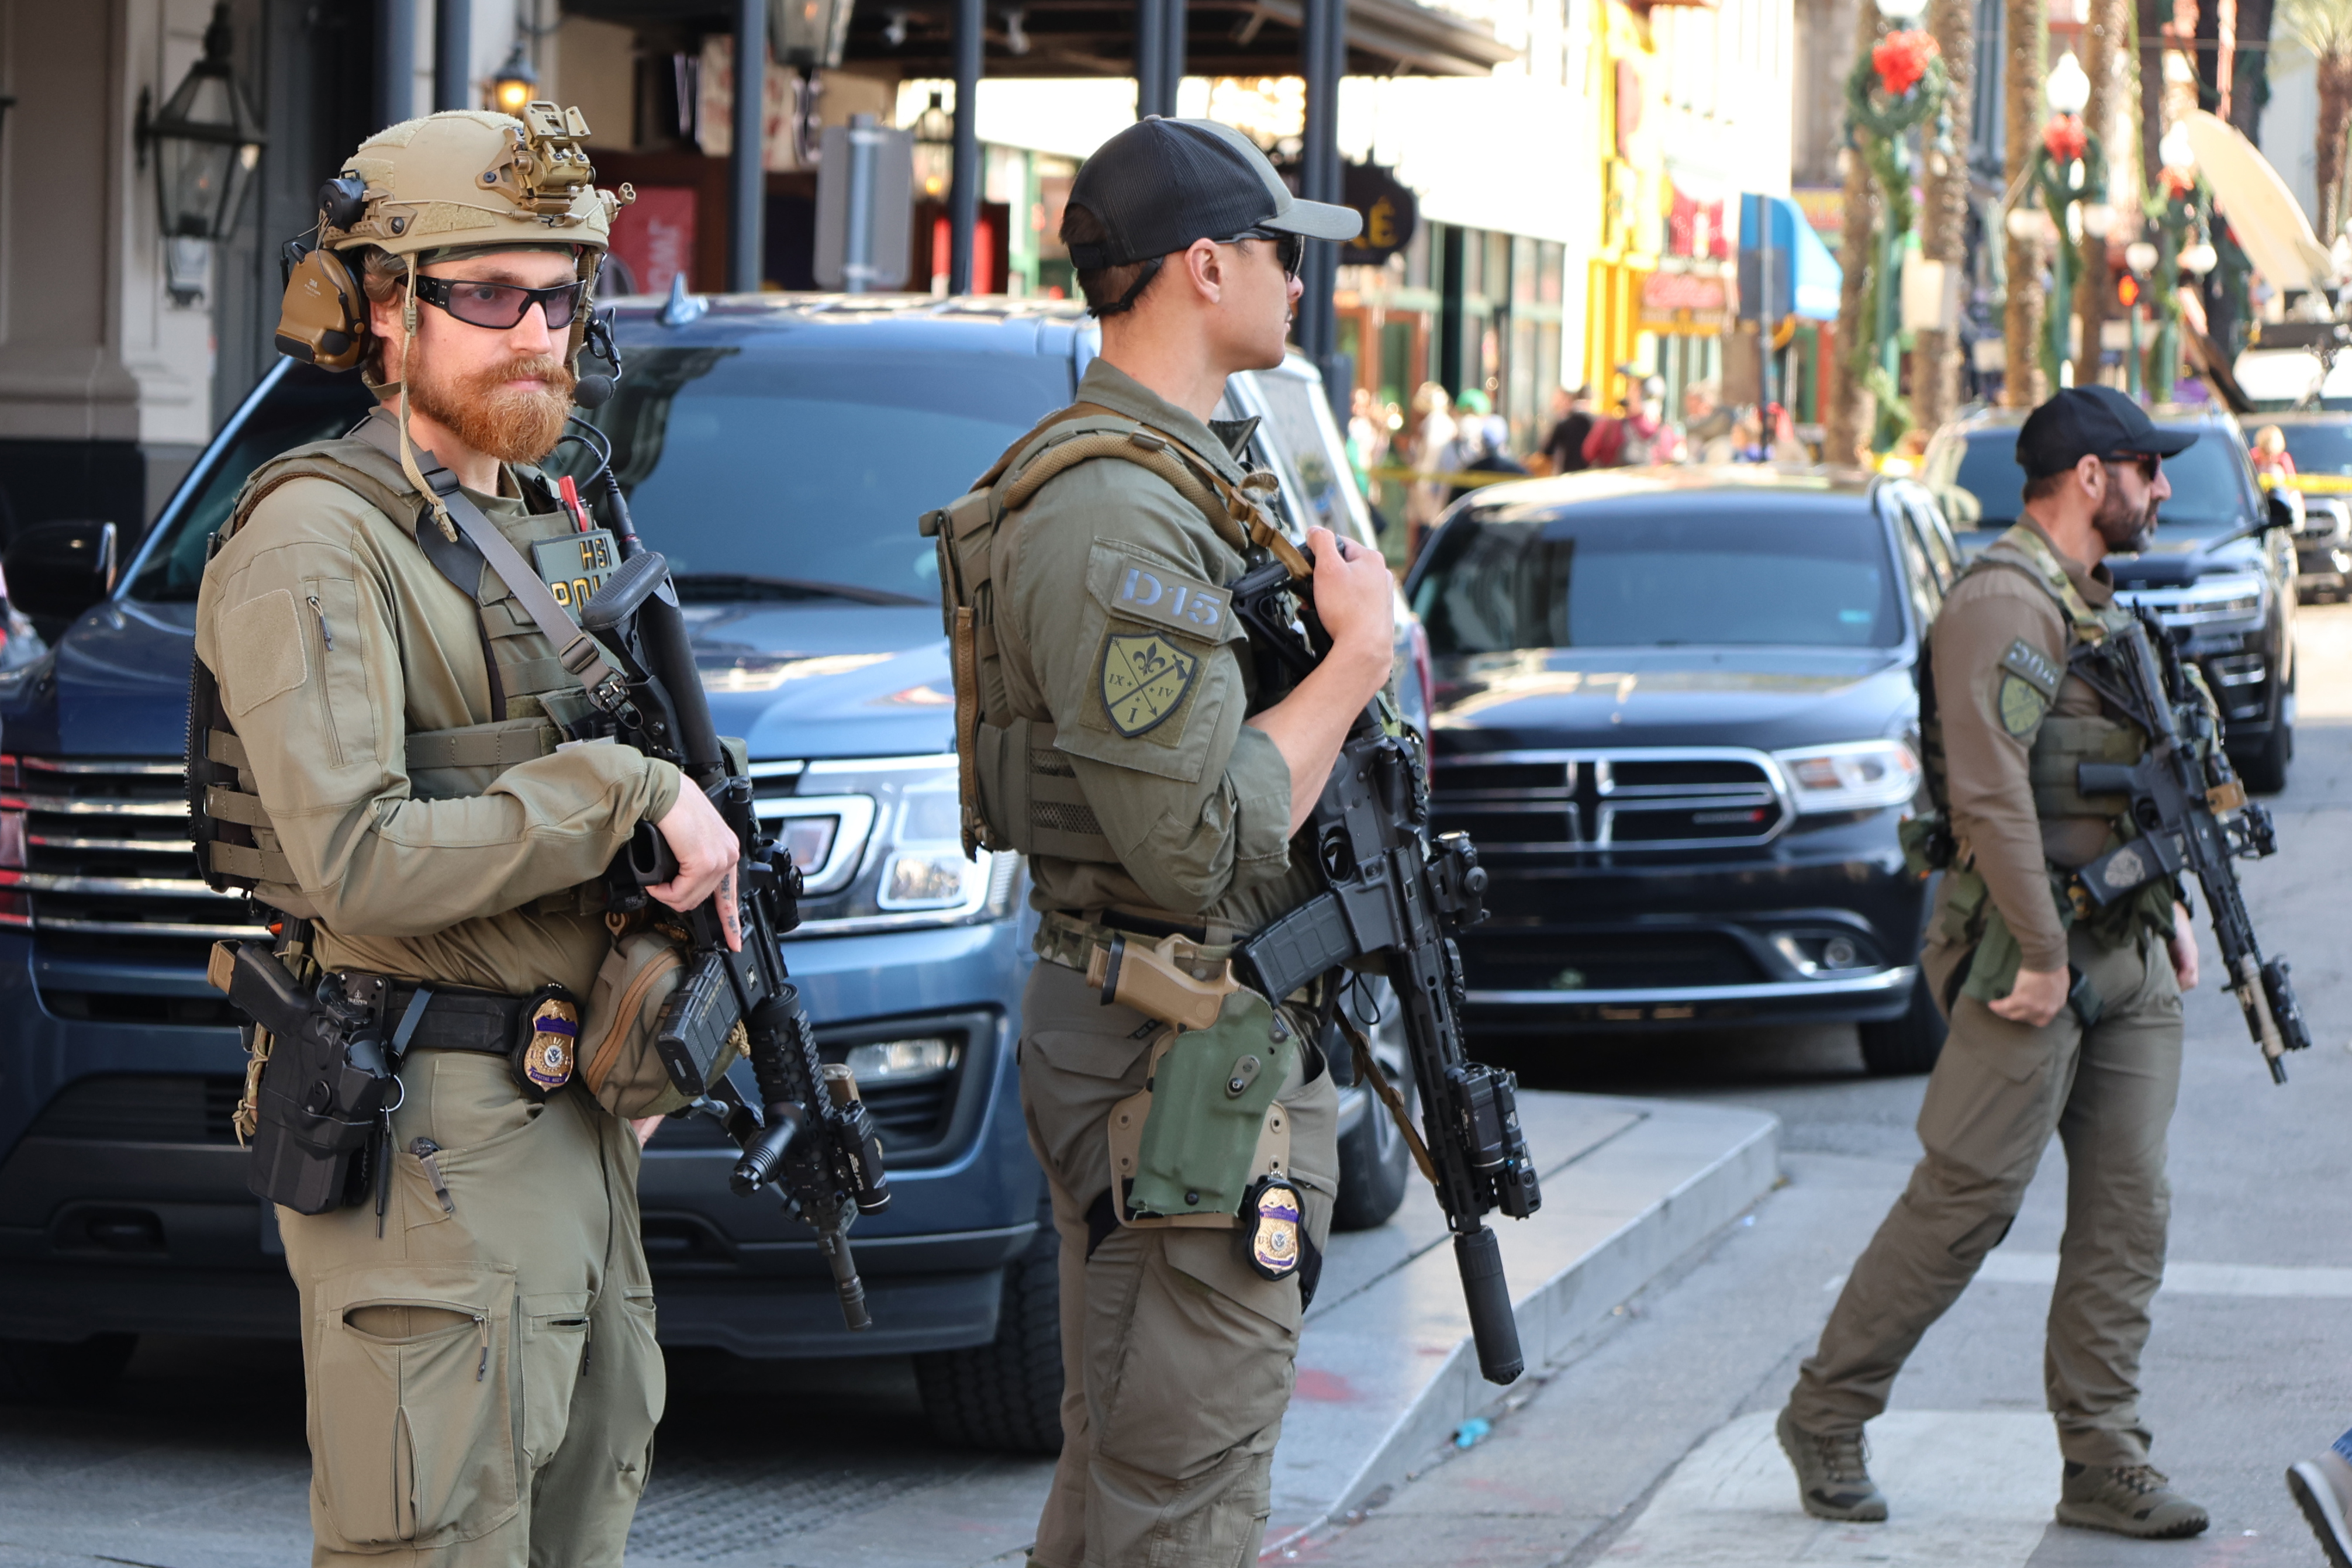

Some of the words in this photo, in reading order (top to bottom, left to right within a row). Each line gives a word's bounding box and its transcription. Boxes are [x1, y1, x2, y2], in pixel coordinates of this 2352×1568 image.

[579, 537, 613, 571] HSI
[1121, 567, 1222, 626] D15
[1107, 674, 1125, 687] IX
[1156, 686, 1174, 699] IV
[1126, 707, 1138, 724] I
